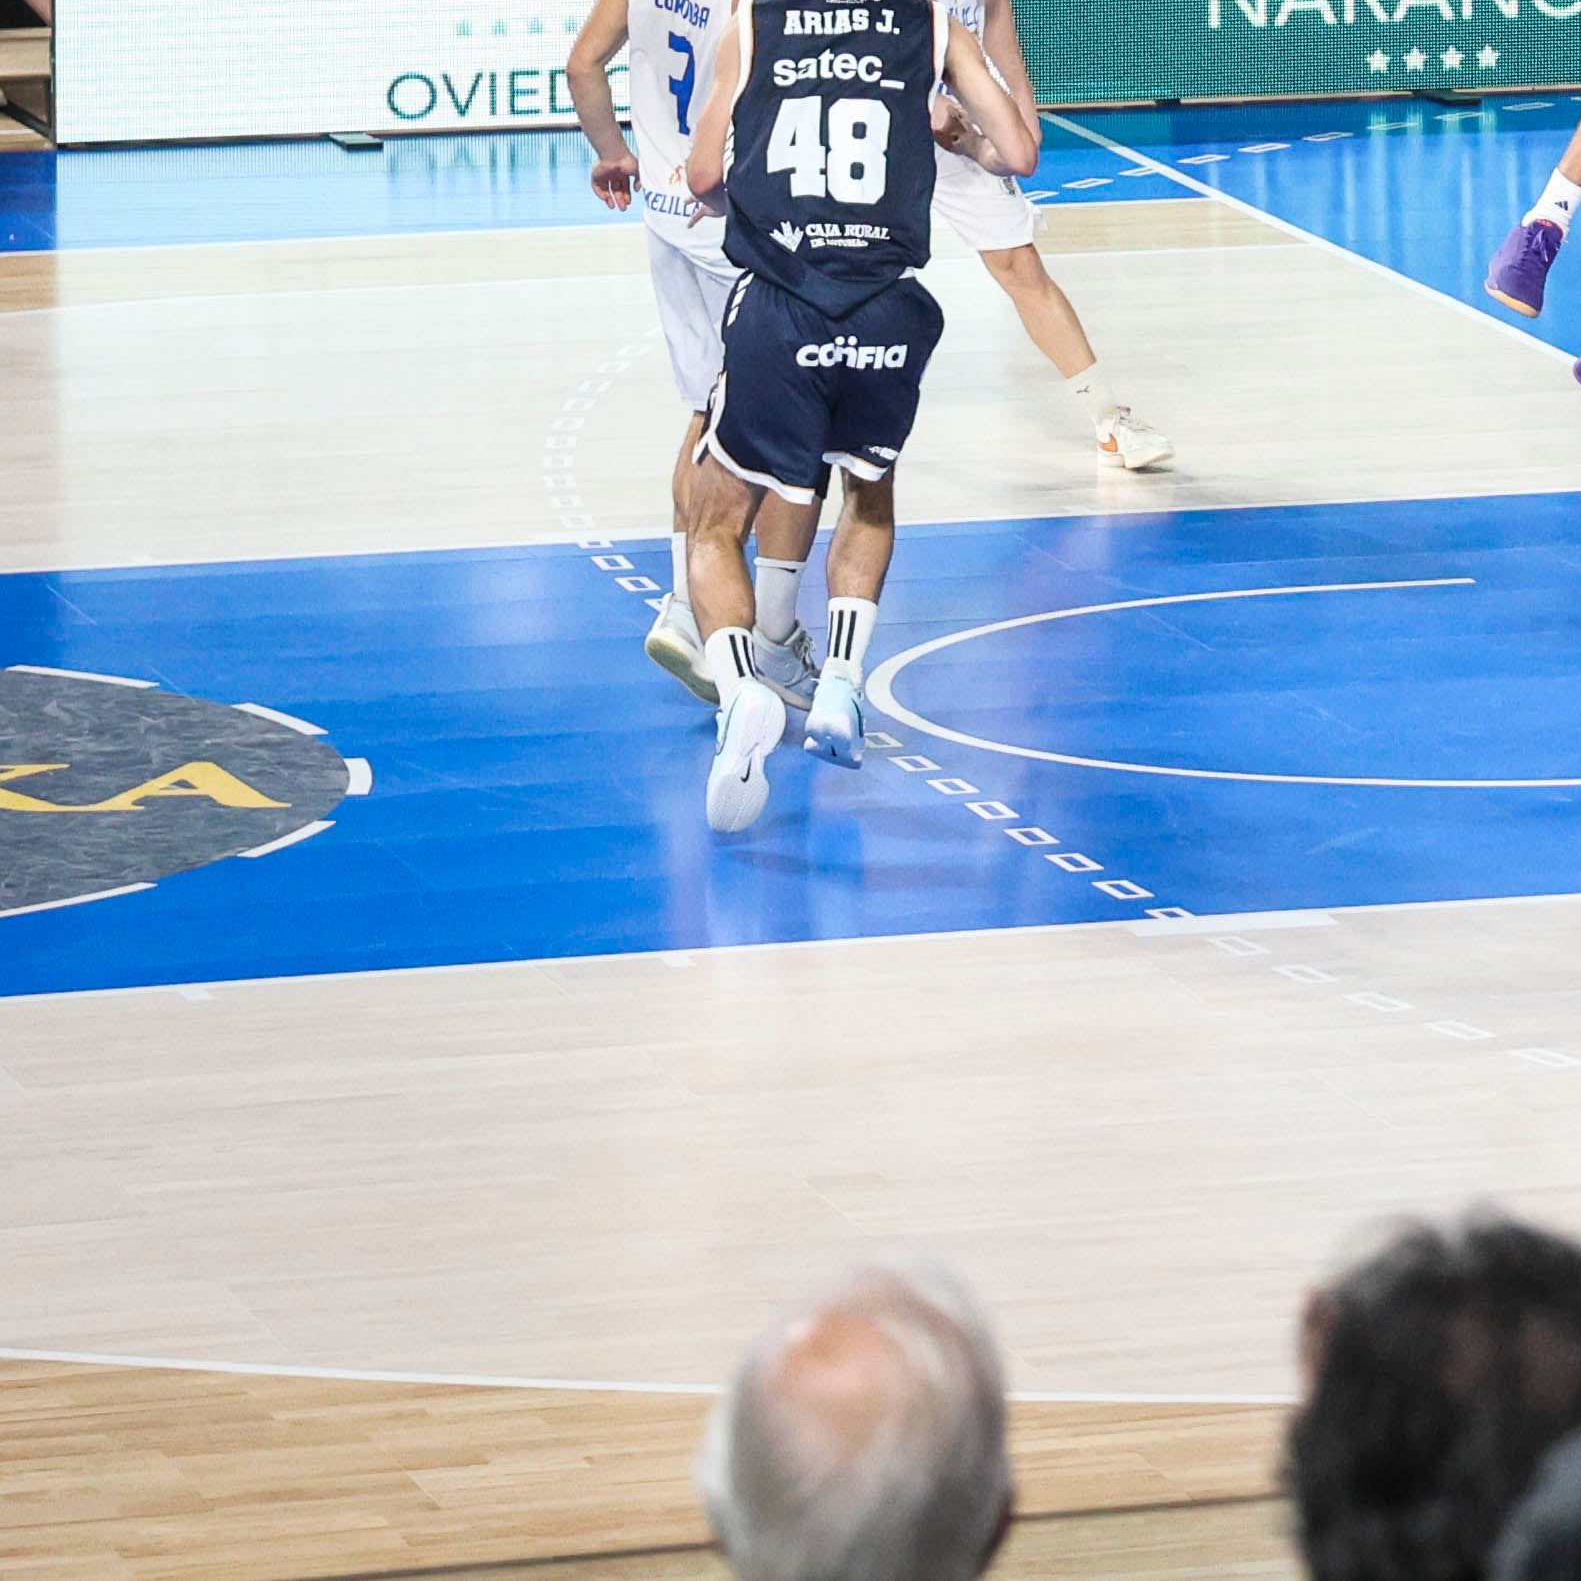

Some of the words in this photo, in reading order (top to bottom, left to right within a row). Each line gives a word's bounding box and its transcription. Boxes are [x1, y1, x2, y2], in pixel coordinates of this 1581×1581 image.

[783, 9, 870, 36] ARIAS
[875, 9, 900, 35] J.
[766, 94, 891, 205] 48
[805, 223, 841, 237] CAJA
[844, 224, 890, 240] RURAL
